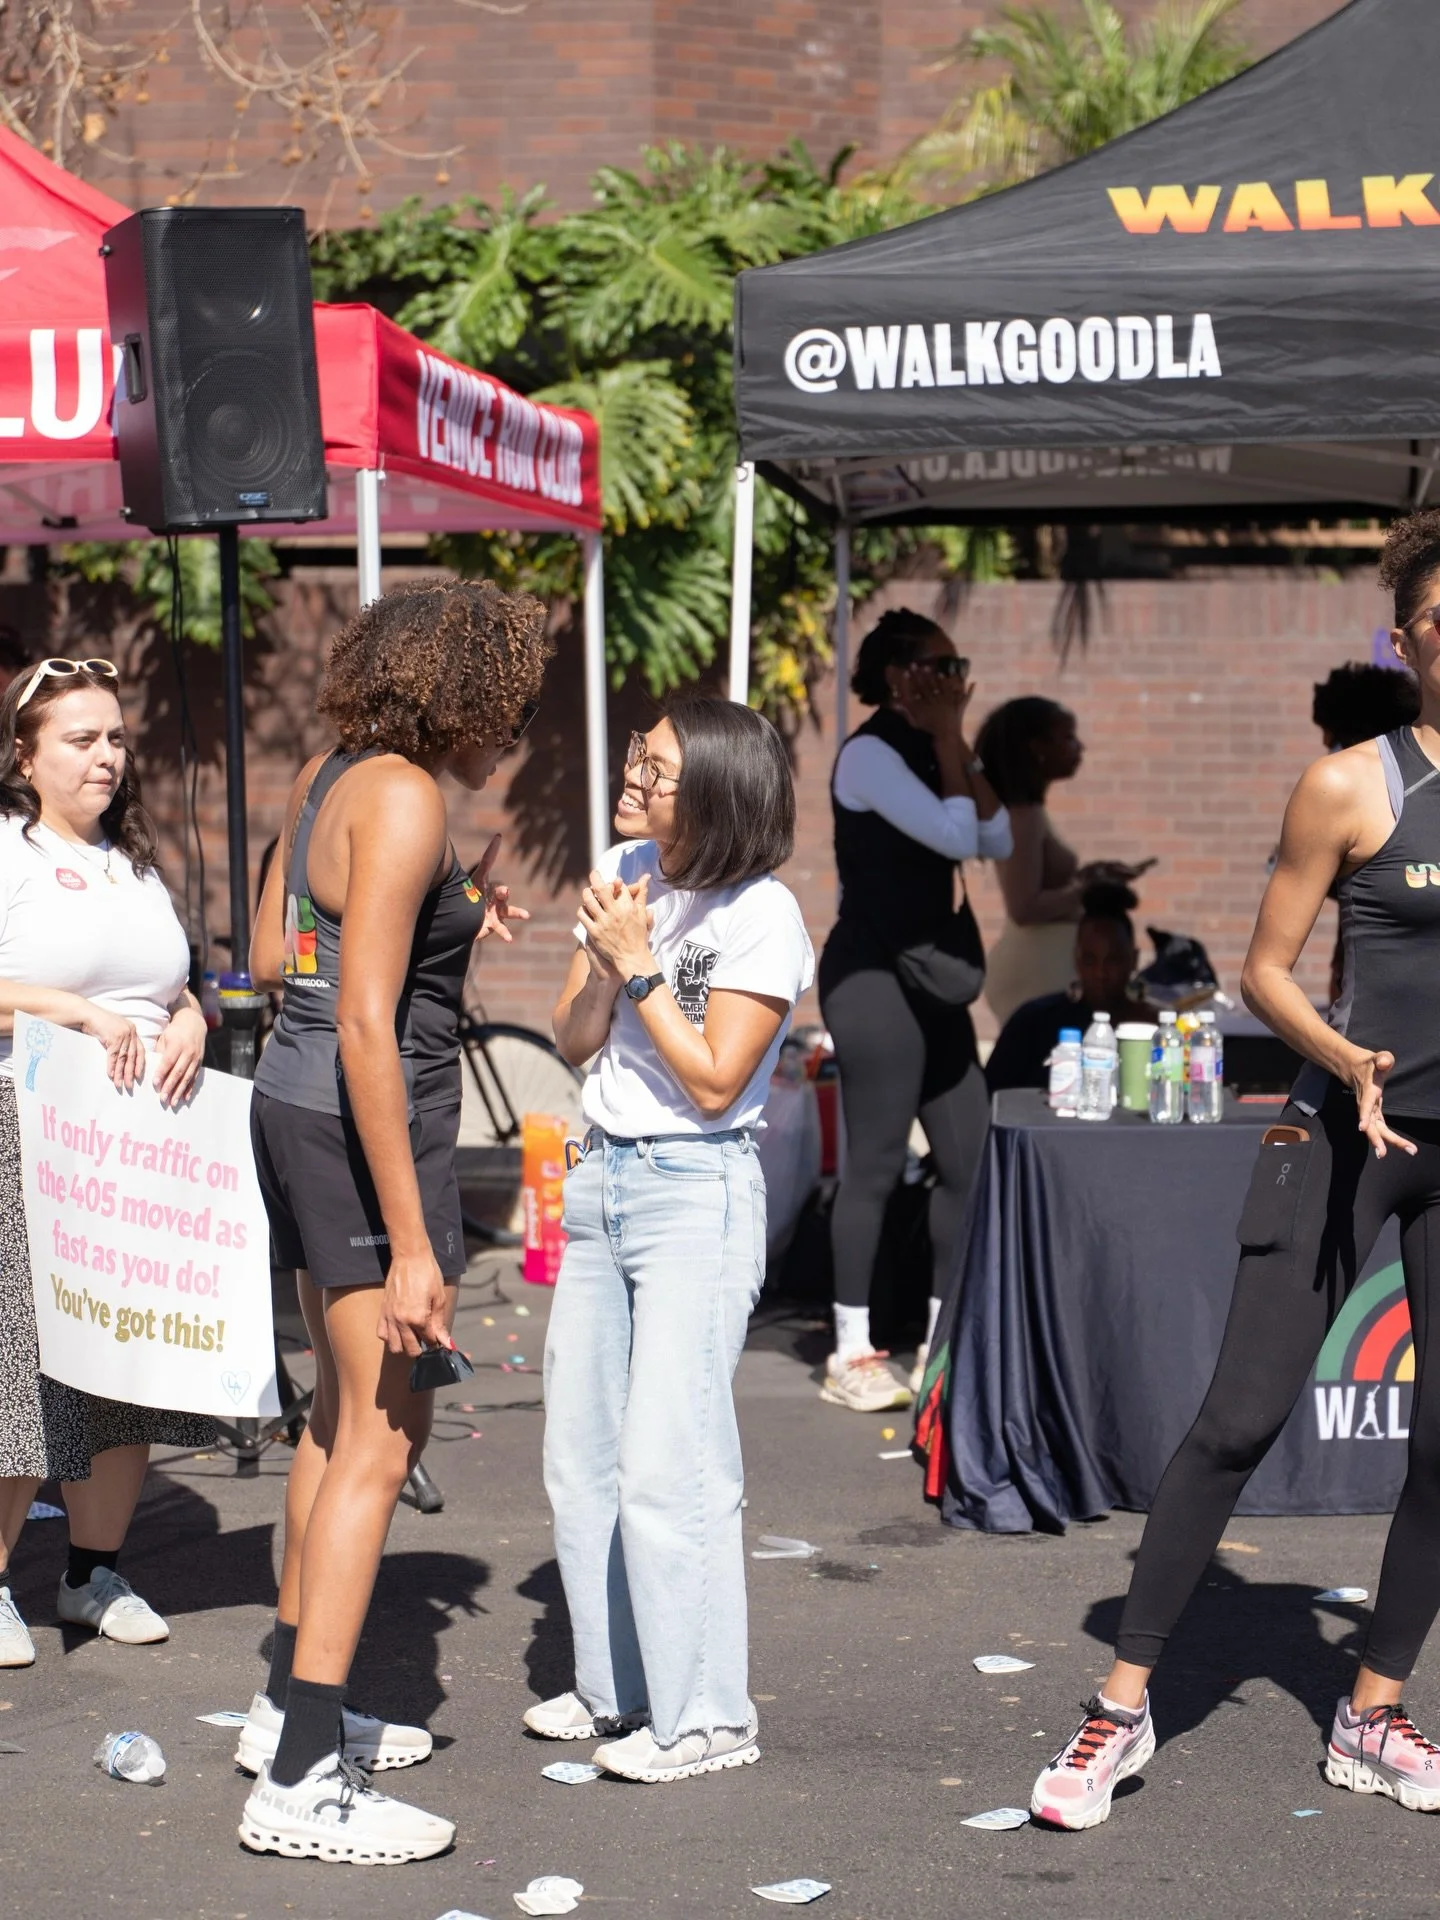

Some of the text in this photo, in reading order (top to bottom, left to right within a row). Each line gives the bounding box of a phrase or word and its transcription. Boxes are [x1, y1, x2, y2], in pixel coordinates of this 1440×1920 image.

[1106, 173, 1440, 235] WALK
[783, 313, 1223, 394] @WALKGOODLA
[42, 1104, 239, 1192] If only traffic on
[37, 1160, 248, 1249] the 405 moved as
[52, 1219, 220, 1298] fast as you do!
[50, 1273, 226, 1353] You've got this!
